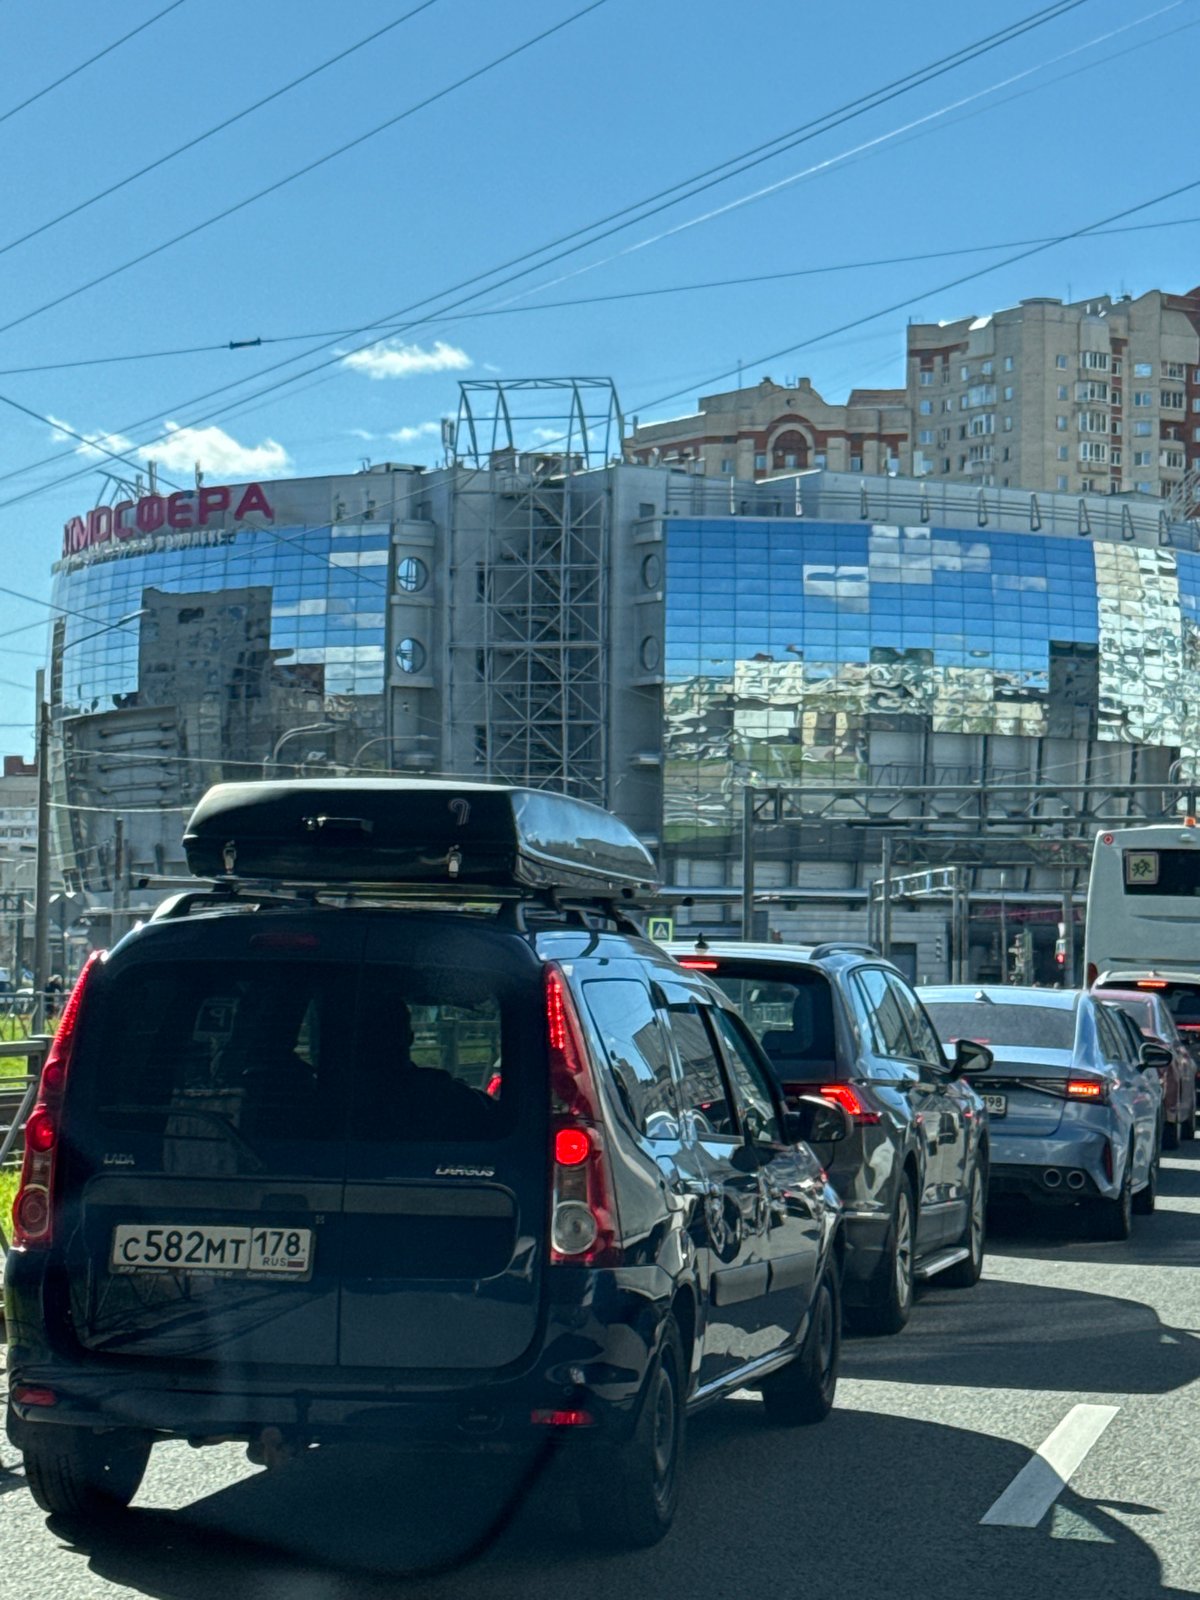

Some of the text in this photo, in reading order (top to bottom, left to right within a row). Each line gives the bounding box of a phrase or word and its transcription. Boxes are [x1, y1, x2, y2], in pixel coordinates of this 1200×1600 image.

[103, 1152, 136, 1165] LADA
[434, 1164, 496, 1177] LARGUS
[122, 1230, 301, 1264] С582МТ 178
[262, 1258, 287, 1267] RUS
